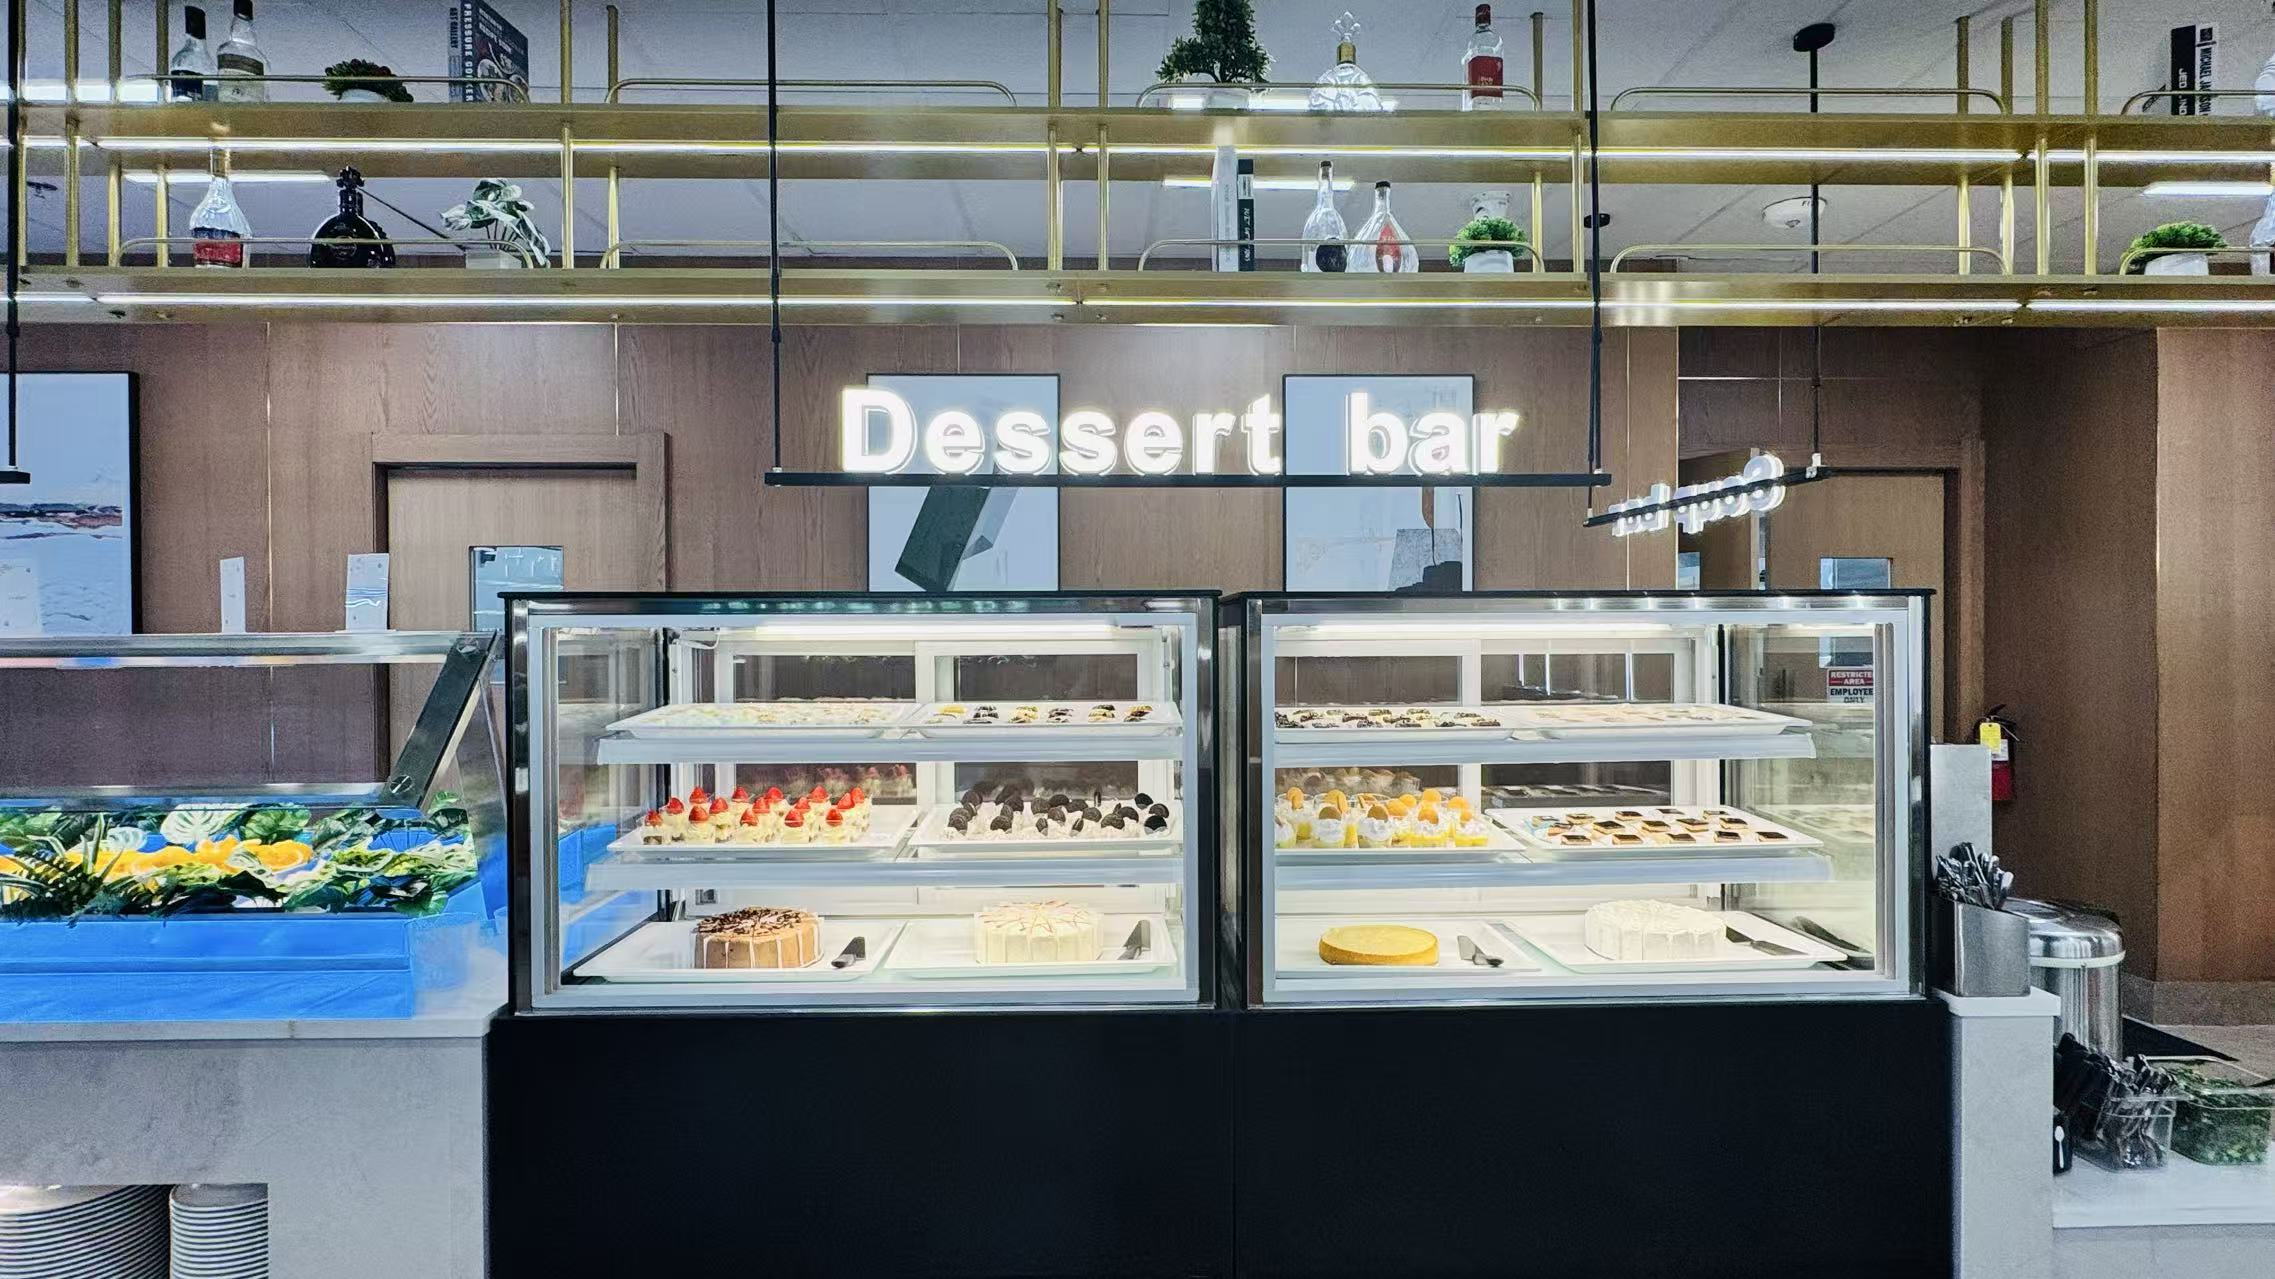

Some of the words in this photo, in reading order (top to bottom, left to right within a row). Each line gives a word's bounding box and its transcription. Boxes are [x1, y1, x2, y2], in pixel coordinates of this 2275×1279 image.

[463, 3, 473, 57] PRESSURE
[2199, 47, 2212, 79] MICHAEL
[2199, 81, 2212, 113] JASON
[841, 388, 1283, 477] Dessert
[1346, 392, 1521, 477] bar
[1830, 688, 1874, 696] EMPLOYEE
